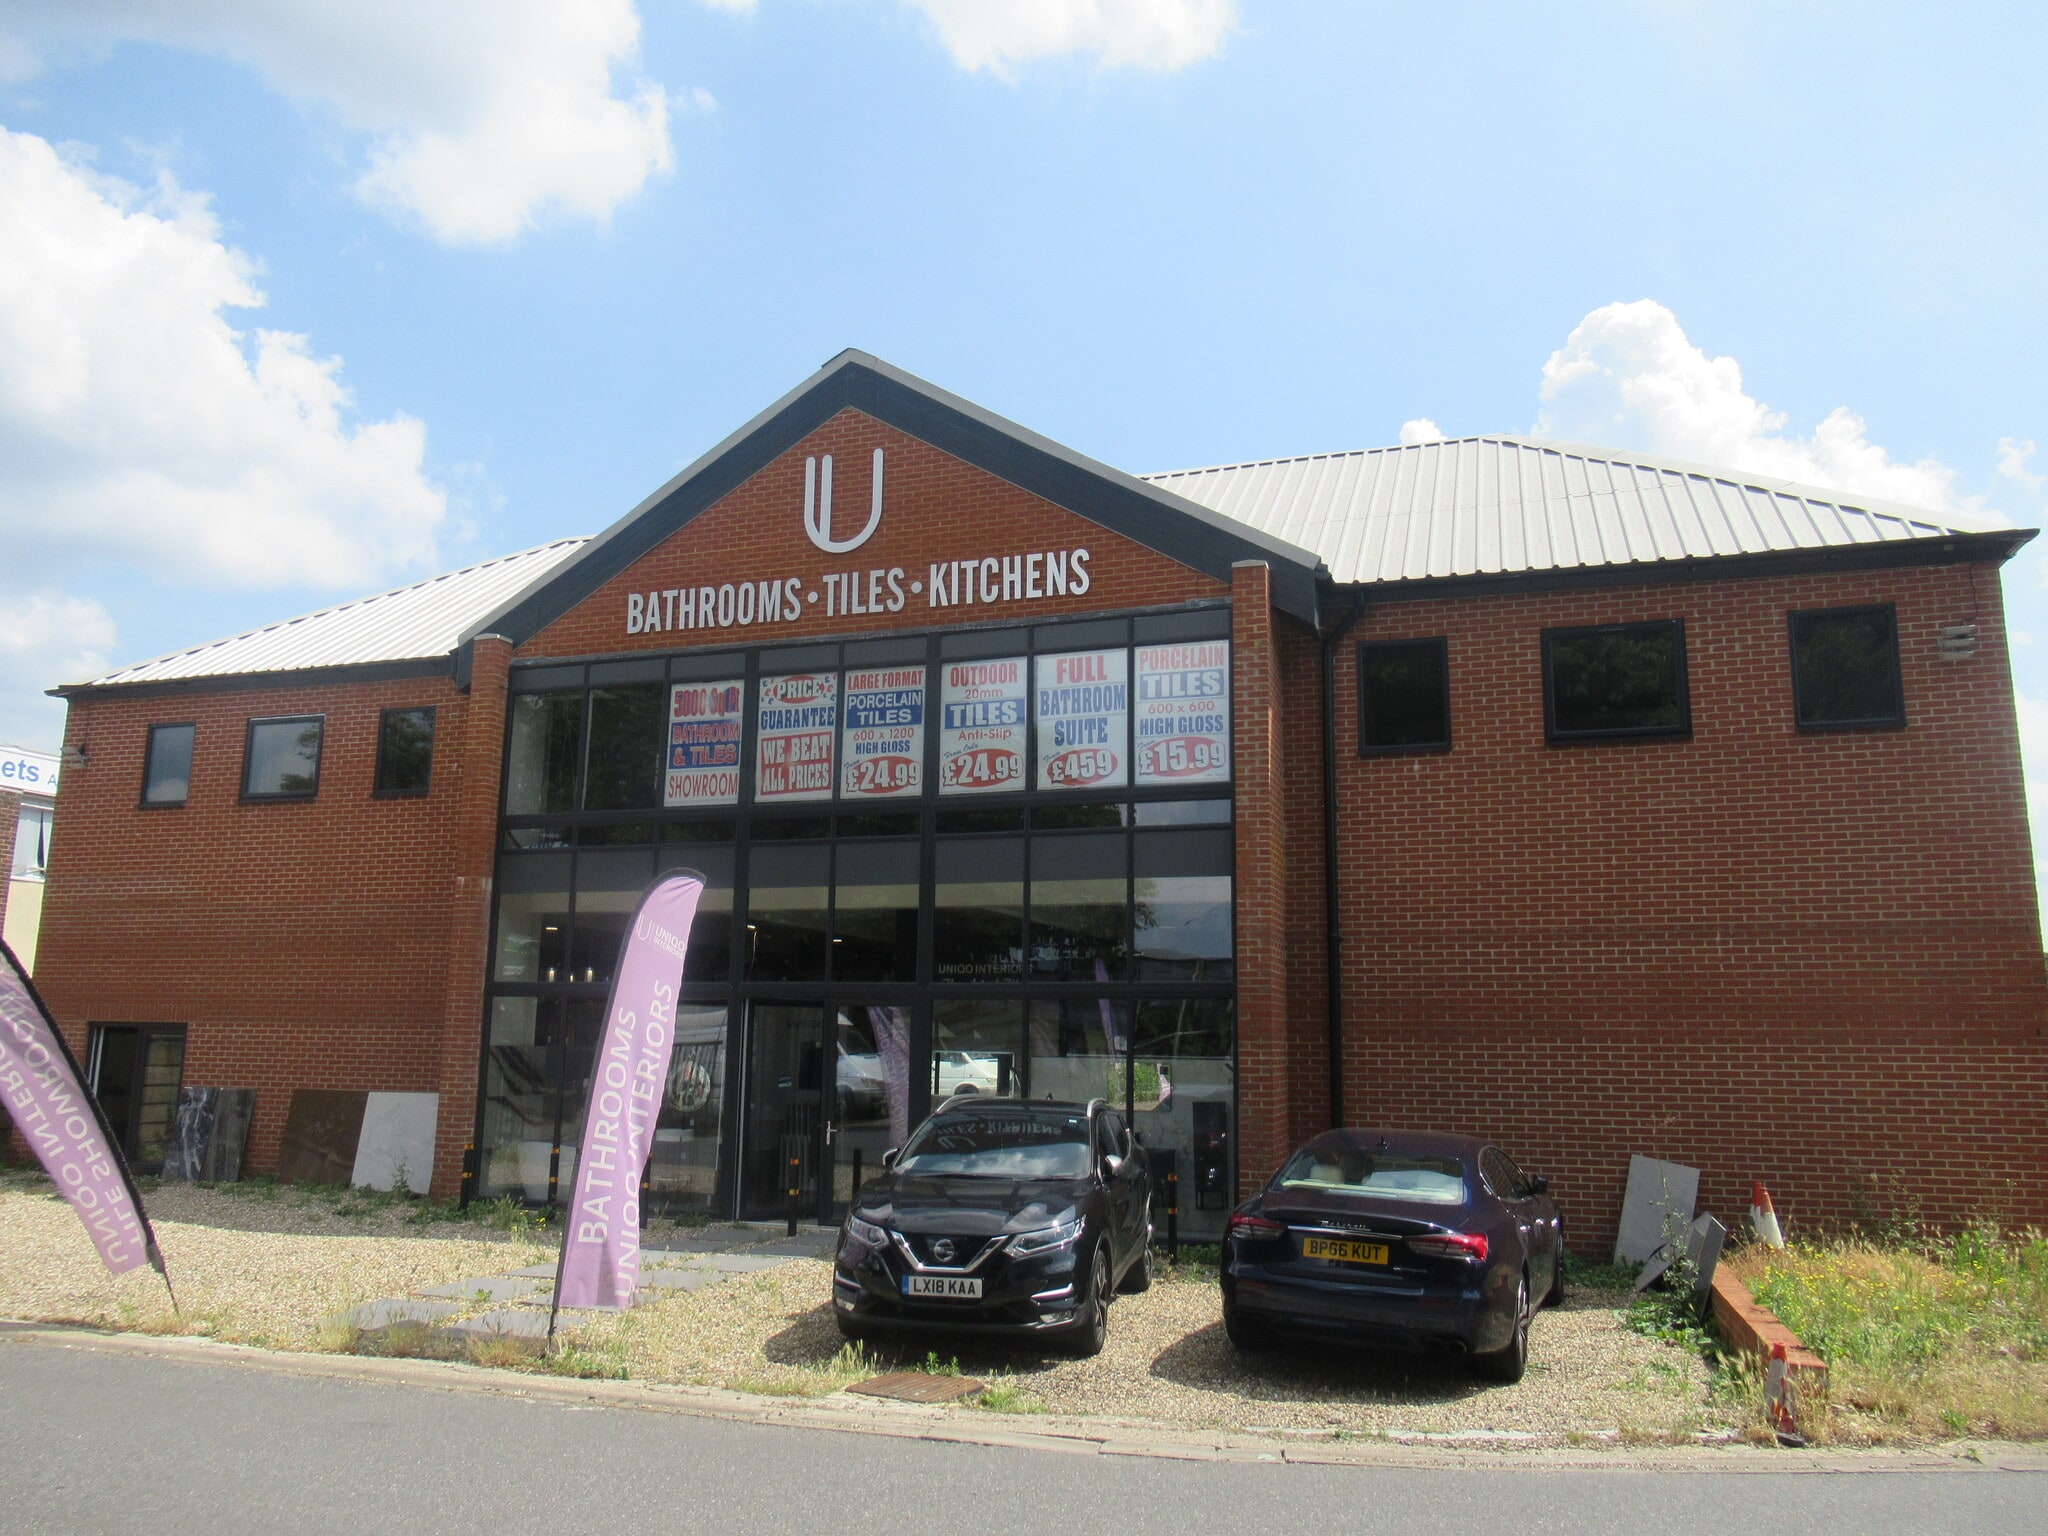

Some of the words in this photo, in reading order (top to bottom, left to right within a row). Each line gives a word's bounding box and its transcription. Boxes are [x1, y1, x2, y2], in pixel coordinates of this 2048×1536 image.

[626, 577, 802, 634] BATHROOMS
[822, 566, 905, 617] TILES
[929, 548, 1090, 608] KITCHENS
[1056, 655, 1108, 684] FULL
[1139, 645, 1225, 671] PORCELAIN
[847, 673, 879, 690] LARGE
[882, 670, 924, 688] FORMAT
[950, 662, 1018, 688] OUTDOOR
[1142, 671, 1221, 698] TILES
[777, 679, 821, 700] PRICE
[848, 691, 921, 709] PORCELAIN
[964, 688, 1003, 700] 20mm
[1040, 684, 1126, 716] BATHROOM
[760, 706, 835, 731] GUARANTEE
[857, 708, 912, 725] TILES
[950, 700, 1018, 728] TILES
[1148, 703, 1173, 714] 600
[1189, 700, 1215, 712] 600
[673, 723, 740, 744] BATHROOM
[853, 729, 874, 741] 600
[889, 727, 915, 739] 1200
[958, 728, 1012, 741] Anti-Slip
[1054, 717, 1108, 747] SUITE
[1140, 717, 1174, 735] HIGH
[1178, 714, 1224, 734] GLOSS
[673, 747, 686, 767] &
[690, 744, 737, 765] TILES
[762, 739, 785, 765] WE
[791, 735, 830, 762] BEAT
[855, 741, 879, 755] HIGH
[881, 740, 911, 754] GLOSS
[1138, 740, 1226, 776] £15.99
[762, 766, 785, 792] ALL
[788, 762, 830, 790] PRICES
[845, 760, 921, 793] £24.99
[942, 753, 1024, 788] £24.99
[1050, 749, 1112, 785] £459
[668, 773, 739, 798] SHOWROOM
[655, 924, 686, 952] UNIQO
[578, 1007, 636, 1243] BATHROOMS
[614, 1170, 640, 1298] UNIQO
[1308, 1240, 1348, 1258] BP66
[1351, 1244, 1381, 1260] KUT
[912, 1278, 944, 1294] LX18
[948, 1278, 976, 1295] KAA
